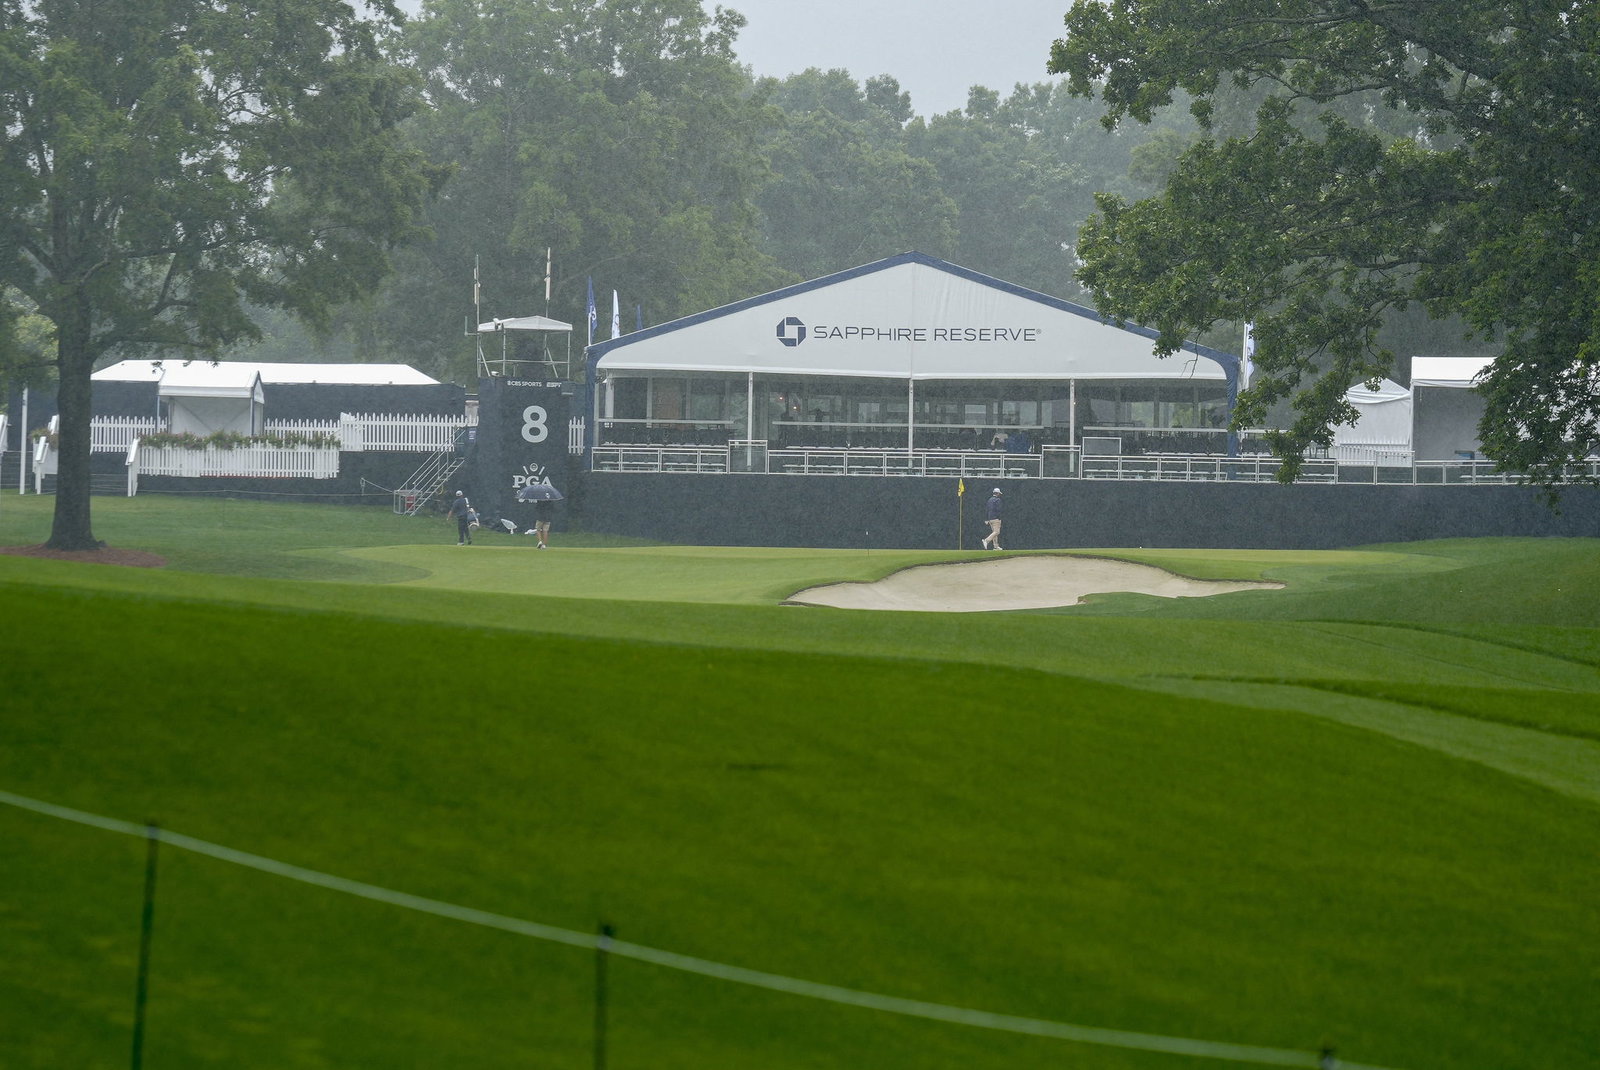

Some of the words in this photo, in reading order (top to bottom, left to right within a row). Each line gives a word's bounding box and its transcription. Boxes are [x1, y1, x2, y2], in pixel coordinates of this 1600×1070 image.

[814, 326, 927, 341] SAPPHIRE
[521, 405, 549, 443] 8
[512, 475, 554, 488] PGA
